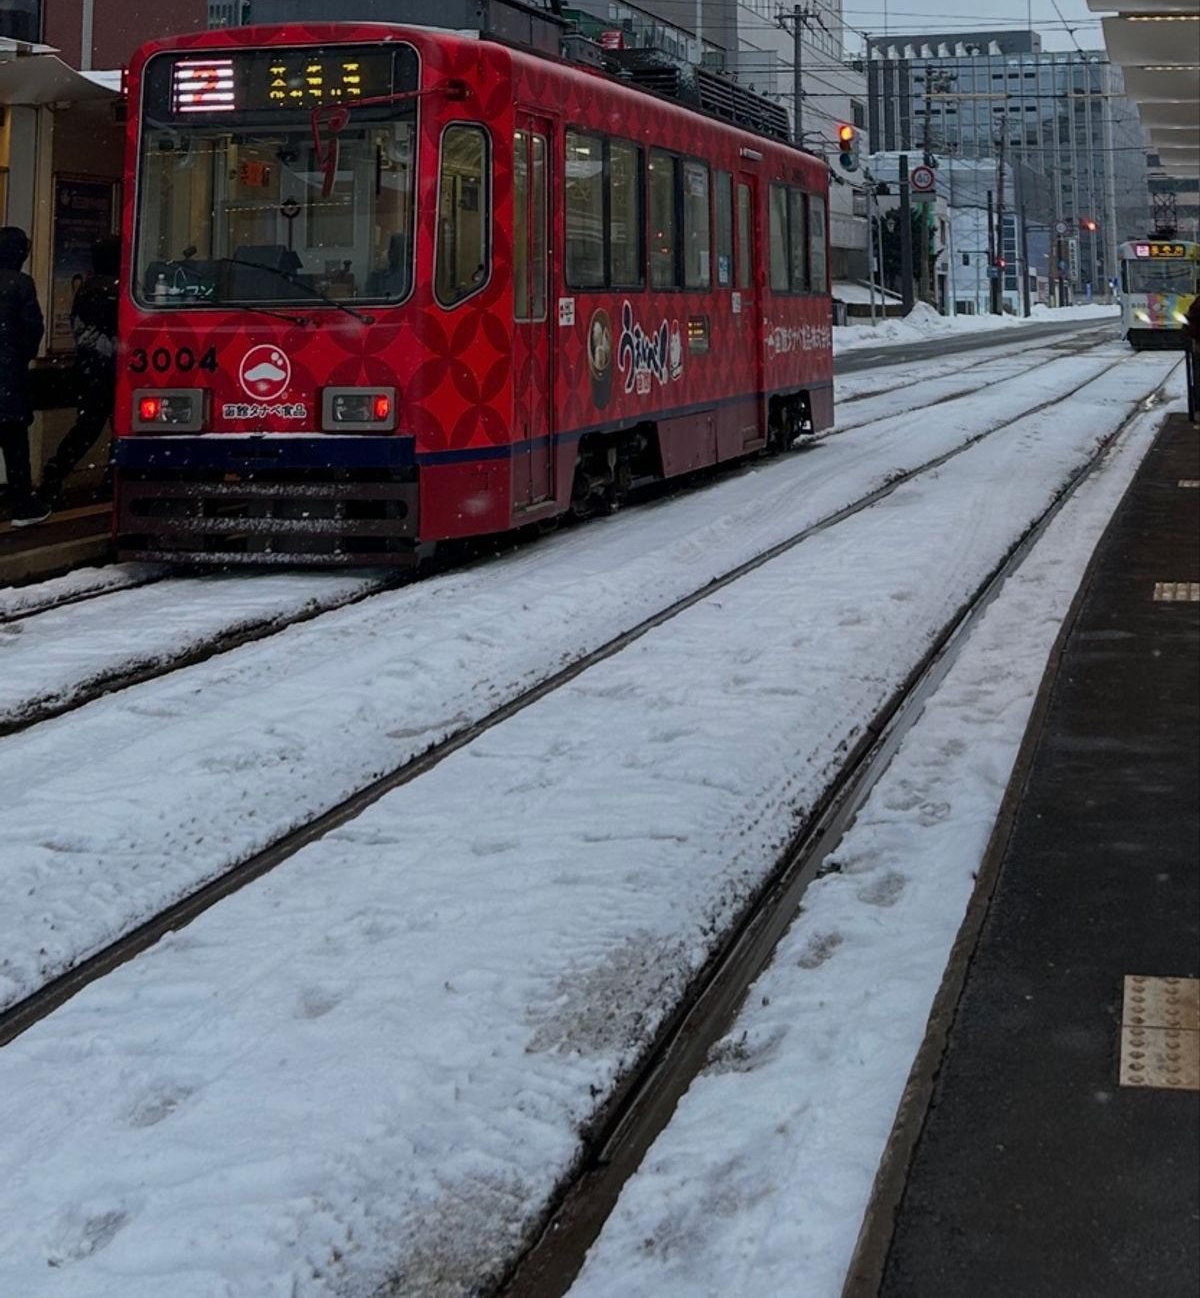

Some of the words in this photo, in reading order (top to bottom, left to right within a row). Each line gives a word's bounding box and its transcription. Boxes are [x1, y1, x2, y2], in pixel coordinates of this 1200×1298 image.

[128, 346, 219, 373] 3004
[222, 403, 307, 420] 函館タナベ食品
